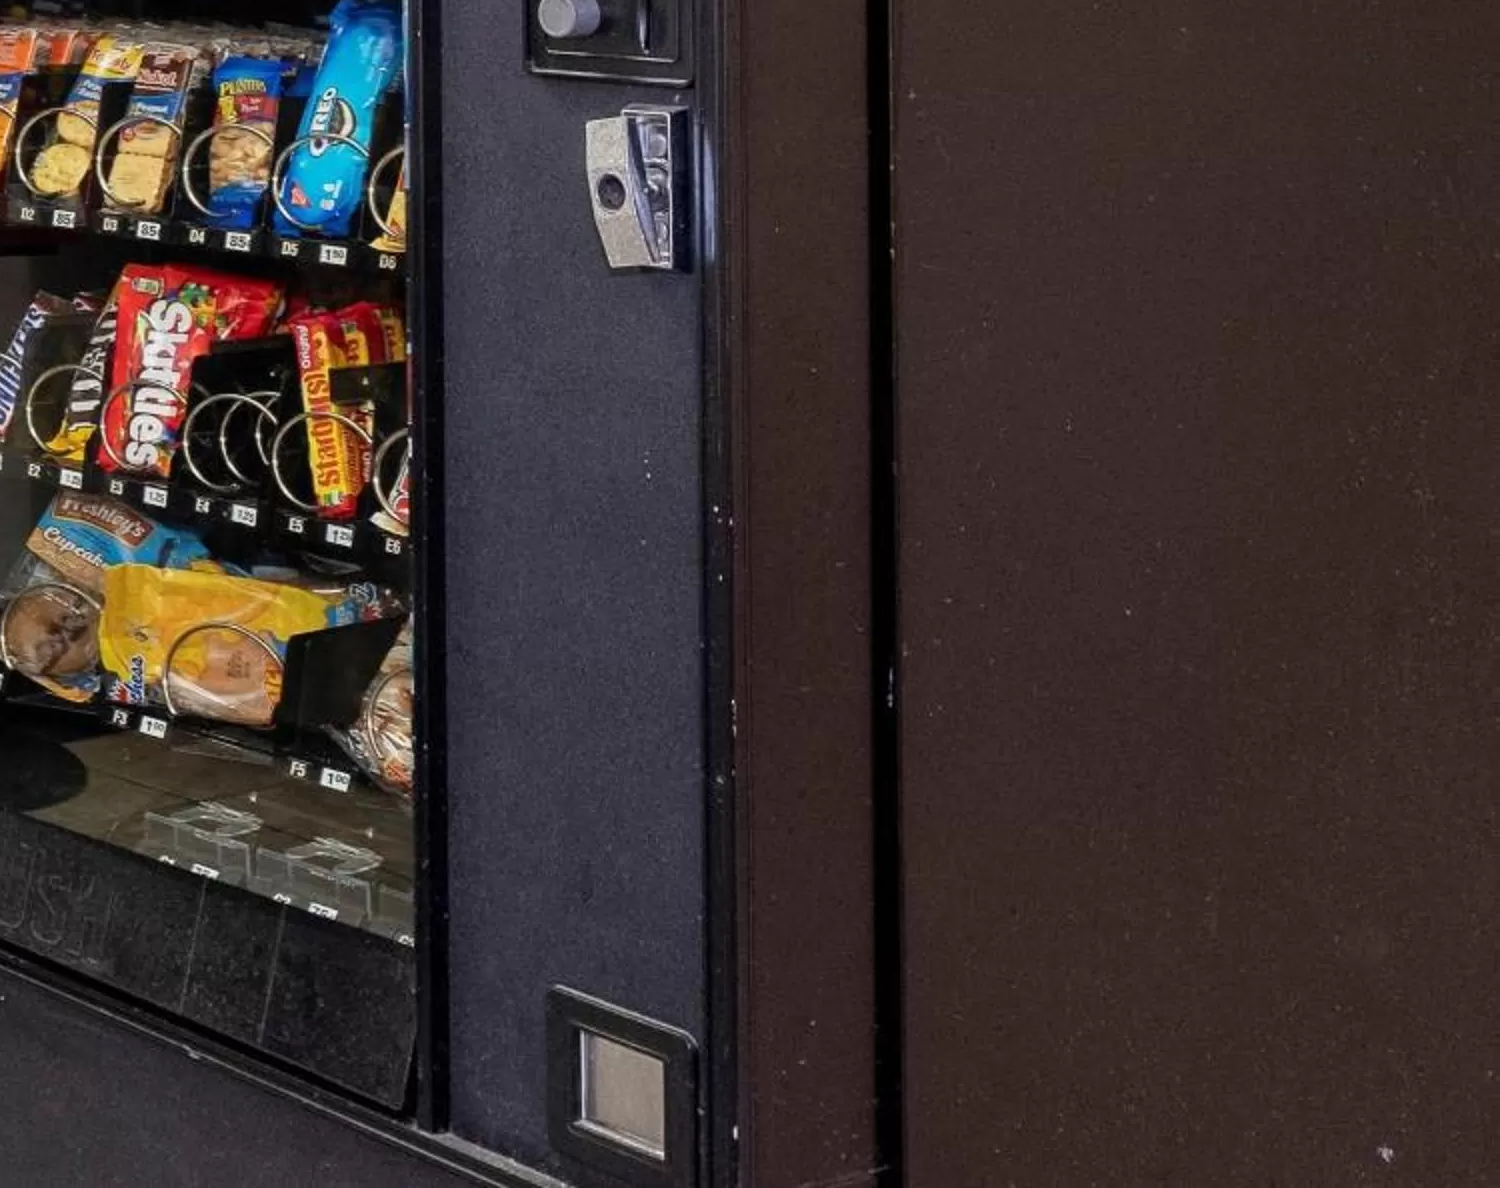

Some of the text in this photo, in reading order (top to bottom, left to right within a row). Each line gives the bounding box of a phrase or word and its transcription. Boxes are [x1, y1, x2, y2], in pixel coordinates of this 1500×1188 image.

[309, 85, 338, 158] OREO
[20, 207, 35, 221] D2
[189, 228, 206, 244] D4
[280, 240, 299, 257] D5
[378, 253, 397, 270] D6
[298, 324, 312, 369] Original
[125, 299, 193, 467] Skittles
[27, 463, 41, 478] E2
[288, 517, 305, 533] E5
[385, 537, 401, 555] E6
[289, 761, 307, 778] F5
